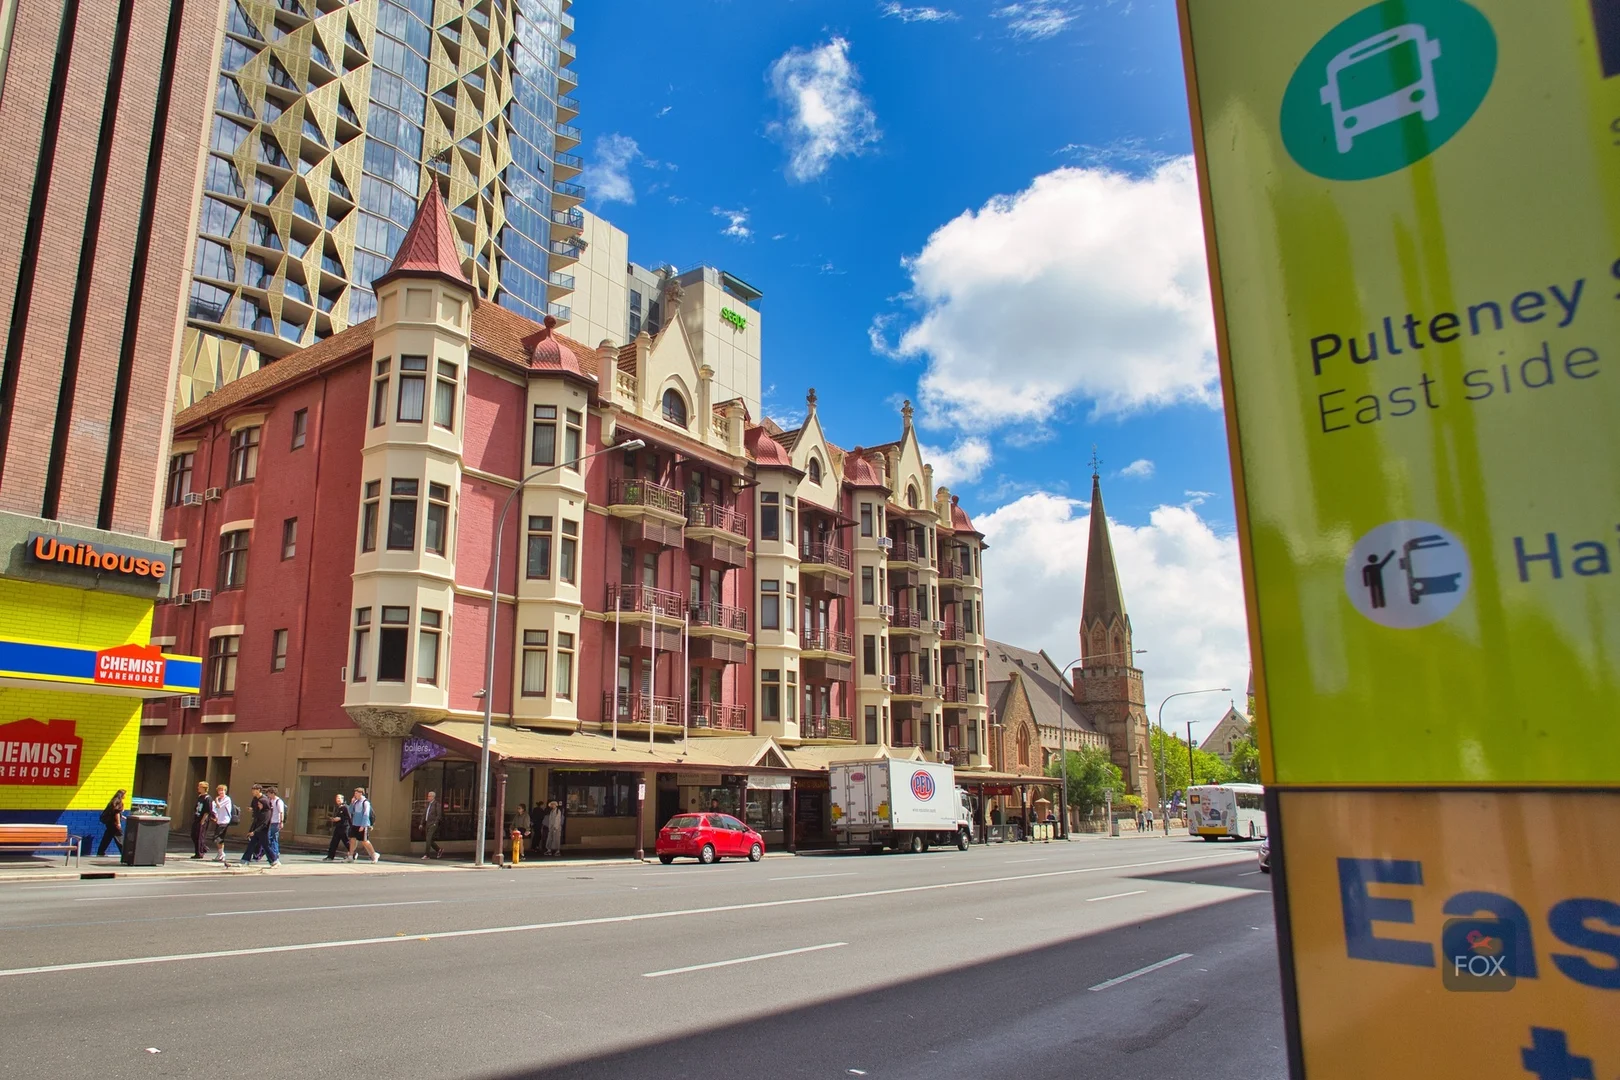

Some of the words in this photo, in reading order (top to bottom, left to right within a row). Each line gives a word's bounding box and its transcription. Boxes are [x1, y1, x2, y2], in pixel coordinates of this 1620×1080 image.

[1310, 277, 1587, 376] Pulteney
[1319, 371, 1439, 433] East
[1463, 341, 1600, 402] side
[35, 536, 166, 578] Unihouse
[99, 671, 160, 684] WAREHOUSE
[100, 655, 163, 674] CHEMIST
[915, 775, 932, 792] PFD
